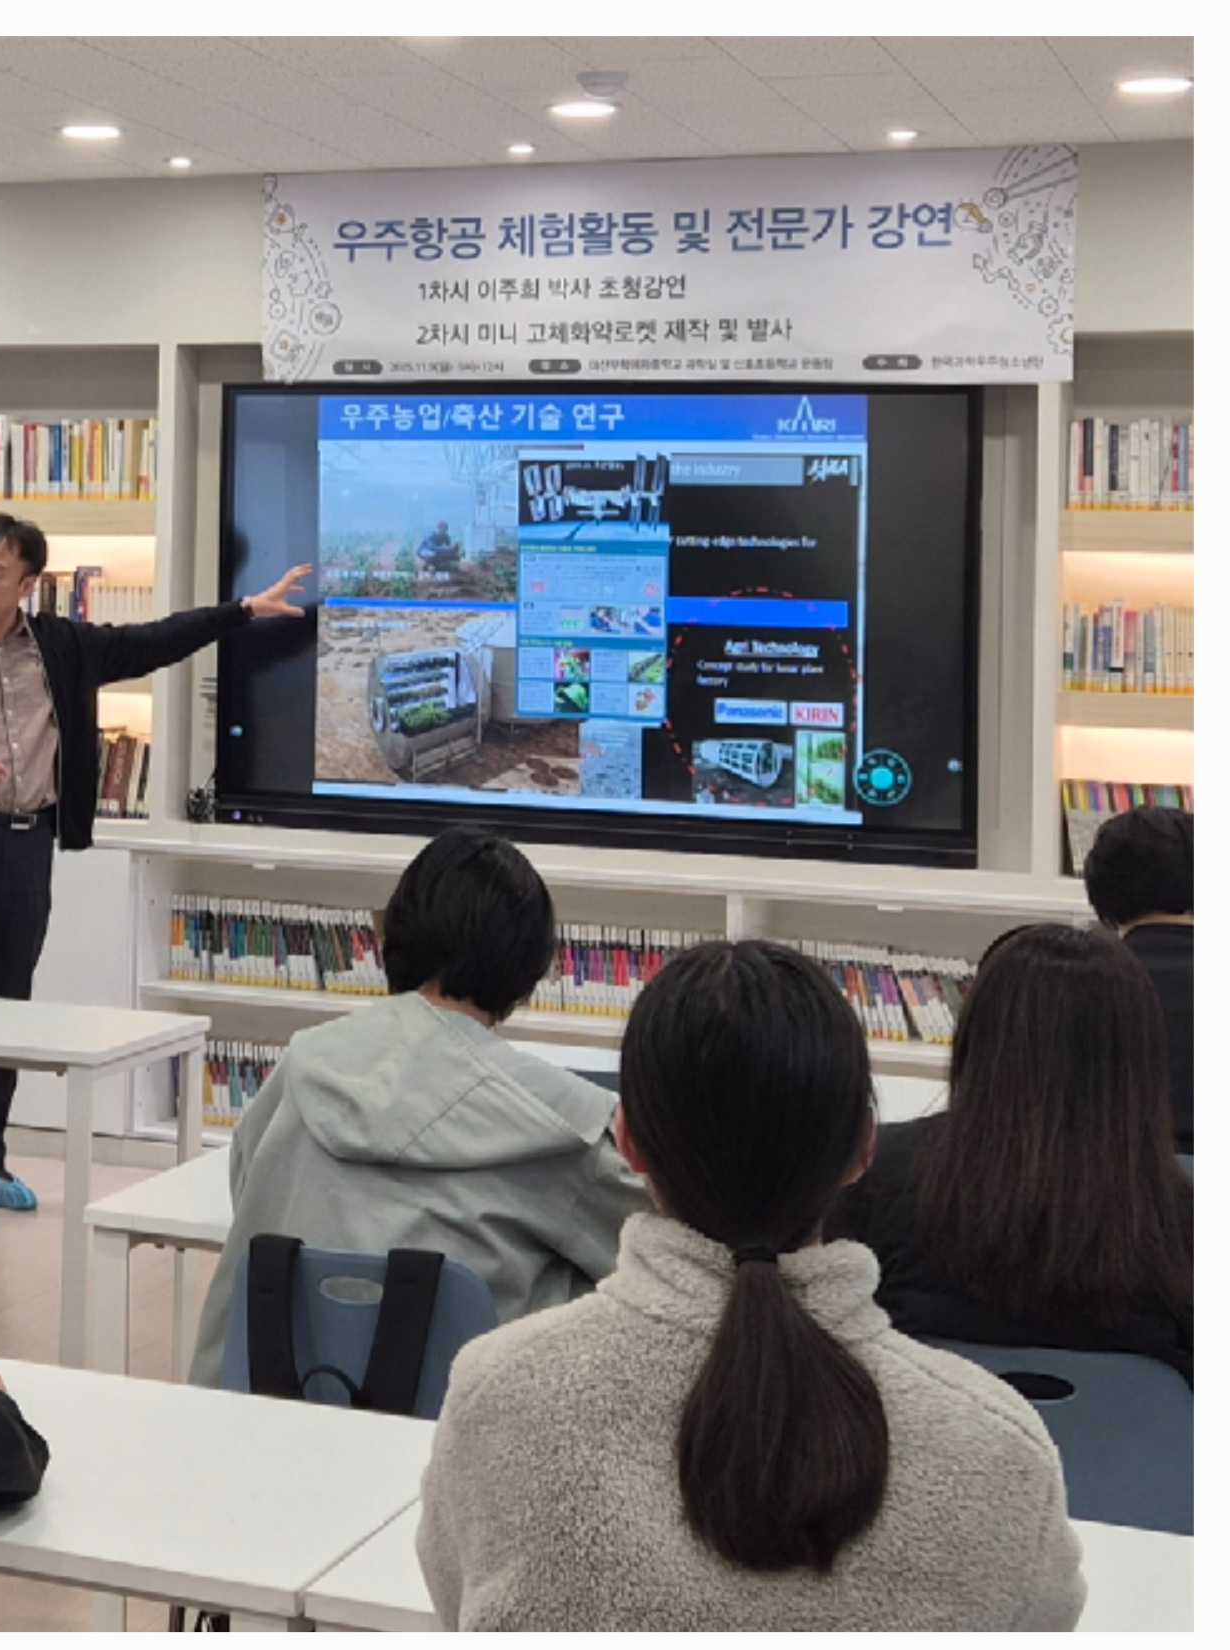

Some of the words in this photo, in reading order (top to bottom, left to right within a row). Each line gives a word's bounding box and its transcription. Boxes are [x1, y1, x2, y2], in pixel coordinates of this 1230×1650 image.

[333, 217, 486, 263] 우주항공
[498, 212, 658, 258] 체험활동
[674, 208, 710, 254] 및
[726, 205, 854, 251] 전문가
[867, 202, 953, 249] 강연
[418, 280, 469, 303] 1차시
[478, 277, 540, 301] 이주희
[548, 276, 591, 299] 박사
[416, 322, 469, 345] 2차시
[478, 321, 518, 344] 미니
[526, 320, 657, 344] 고체화약로켓
[665, 319, 710, 342] 제작
[719, 318, 738, 342] 및
[747, 317, 793, 341] 발사
[340, 403, 504, 431] 우주농업/축산
[511, 403, 563, 431] 기술
[572, 403, 625, 431] 연구
[717, 702, 784, 719] Panasonic
[795, 706, 838, 723] KIRIN
